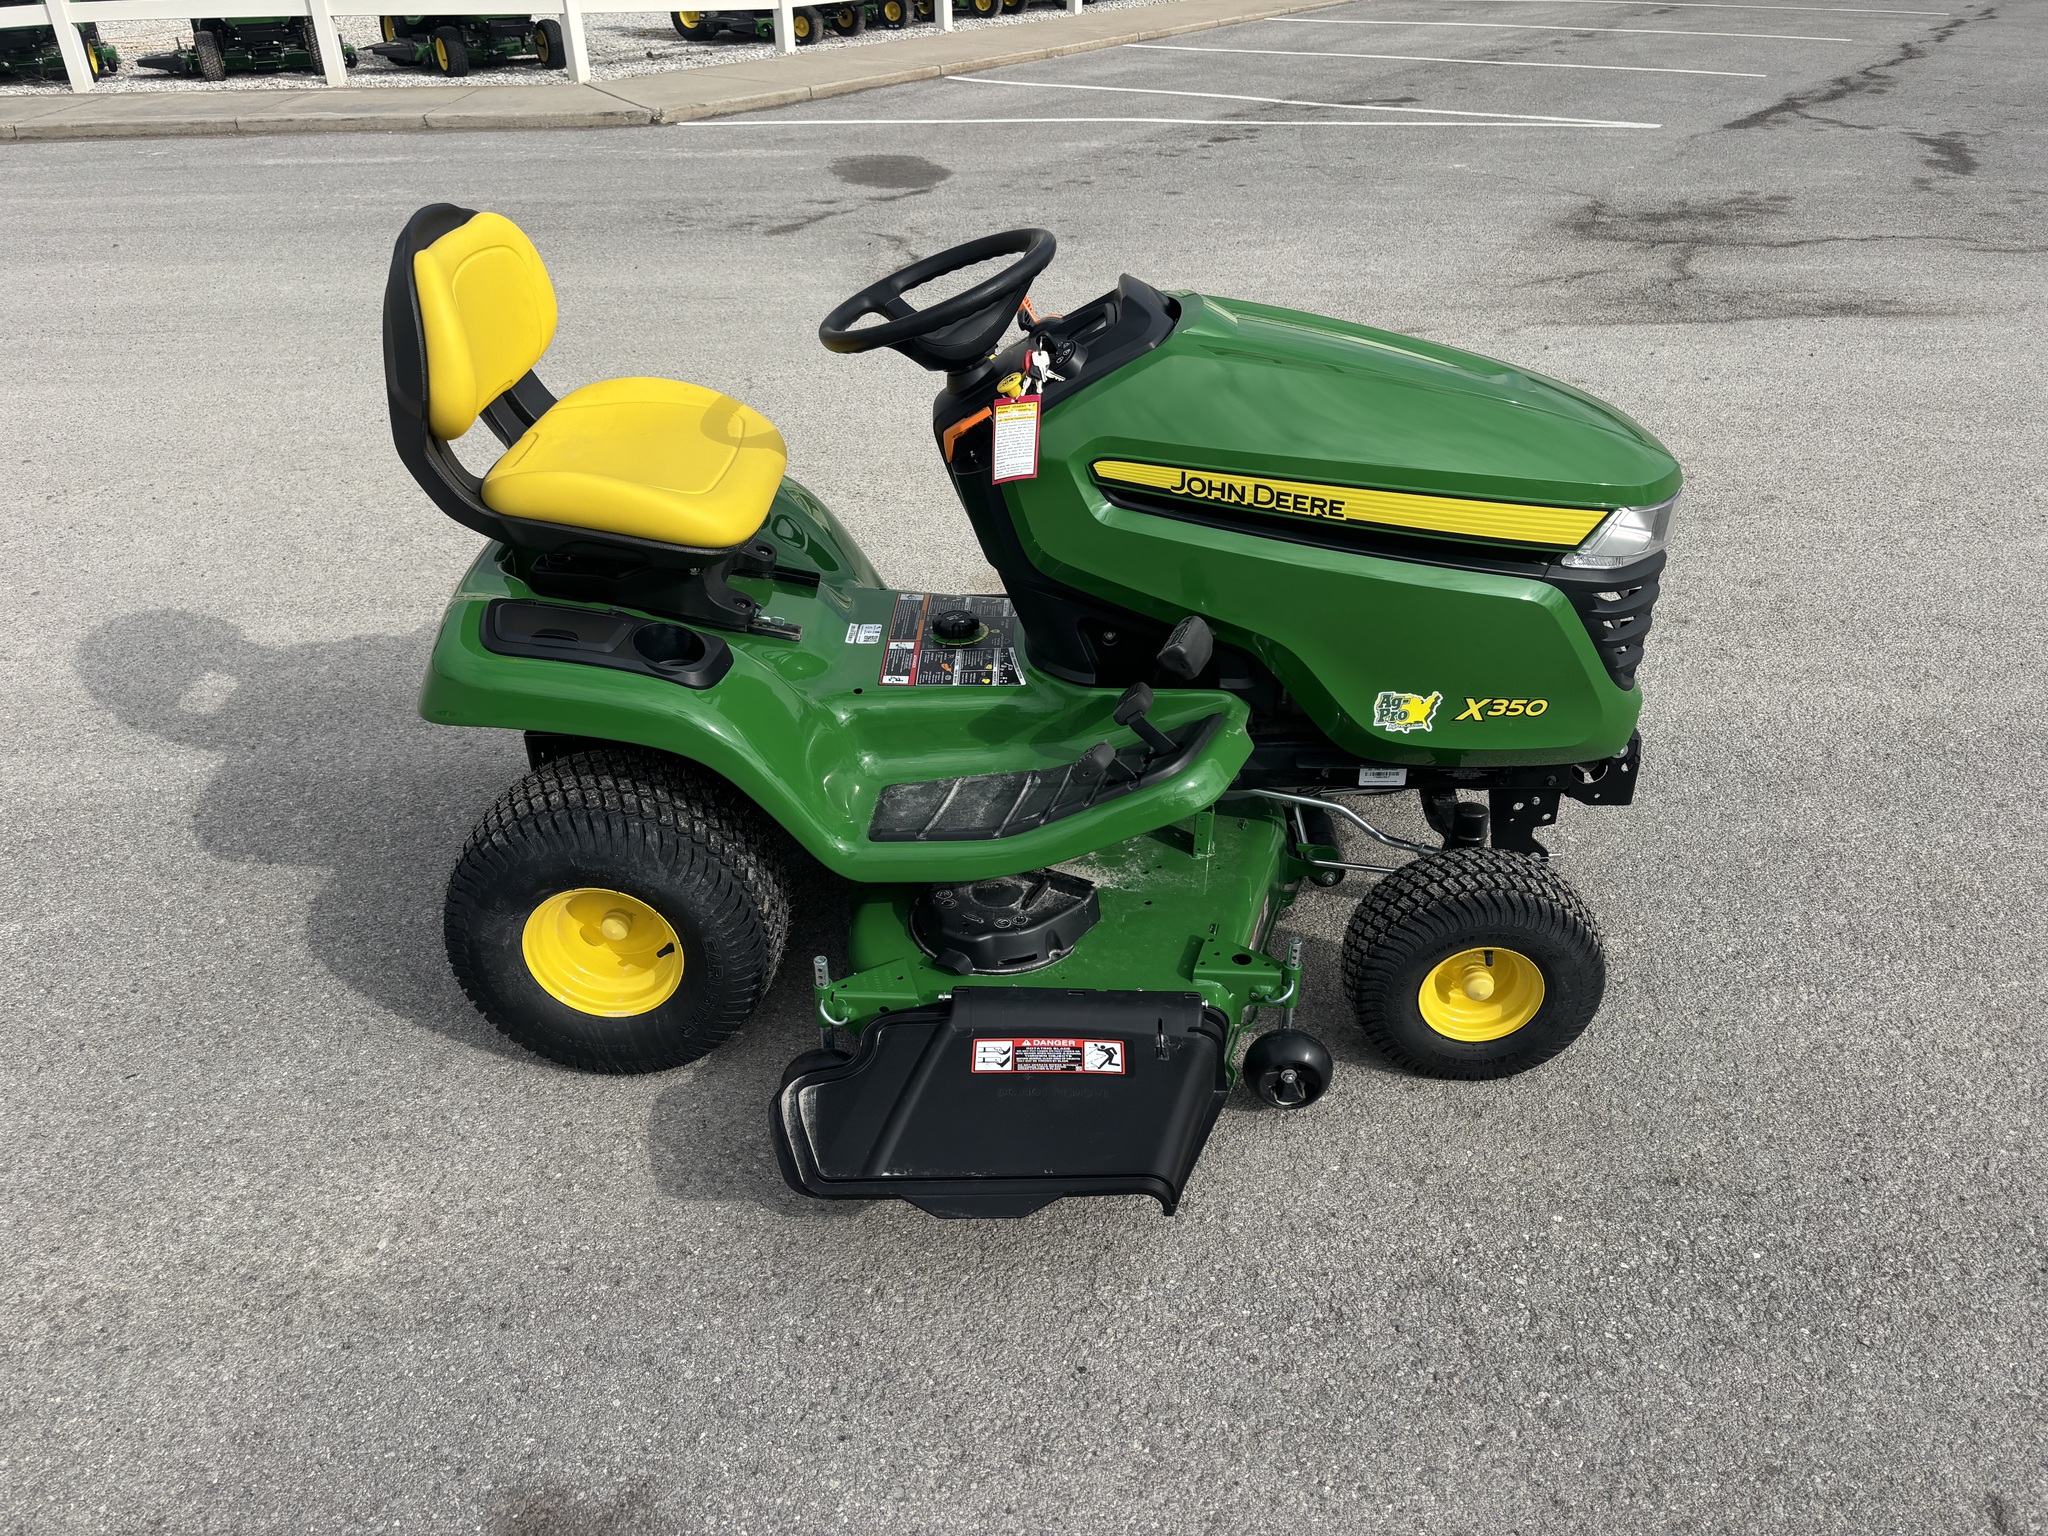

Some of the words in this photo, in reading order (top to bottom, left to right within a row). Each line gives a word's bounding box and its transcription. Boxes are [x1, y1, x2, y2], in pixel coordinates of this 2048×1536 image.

[1170, 471, 1246, 503] JOHN
[1253, 483, 1346, 518] DEERE
[1378, 694, 1410, 710] Ag-
[1453, 696, 1550, 722] X350
[1378, 708, 1409, 723] Pro
